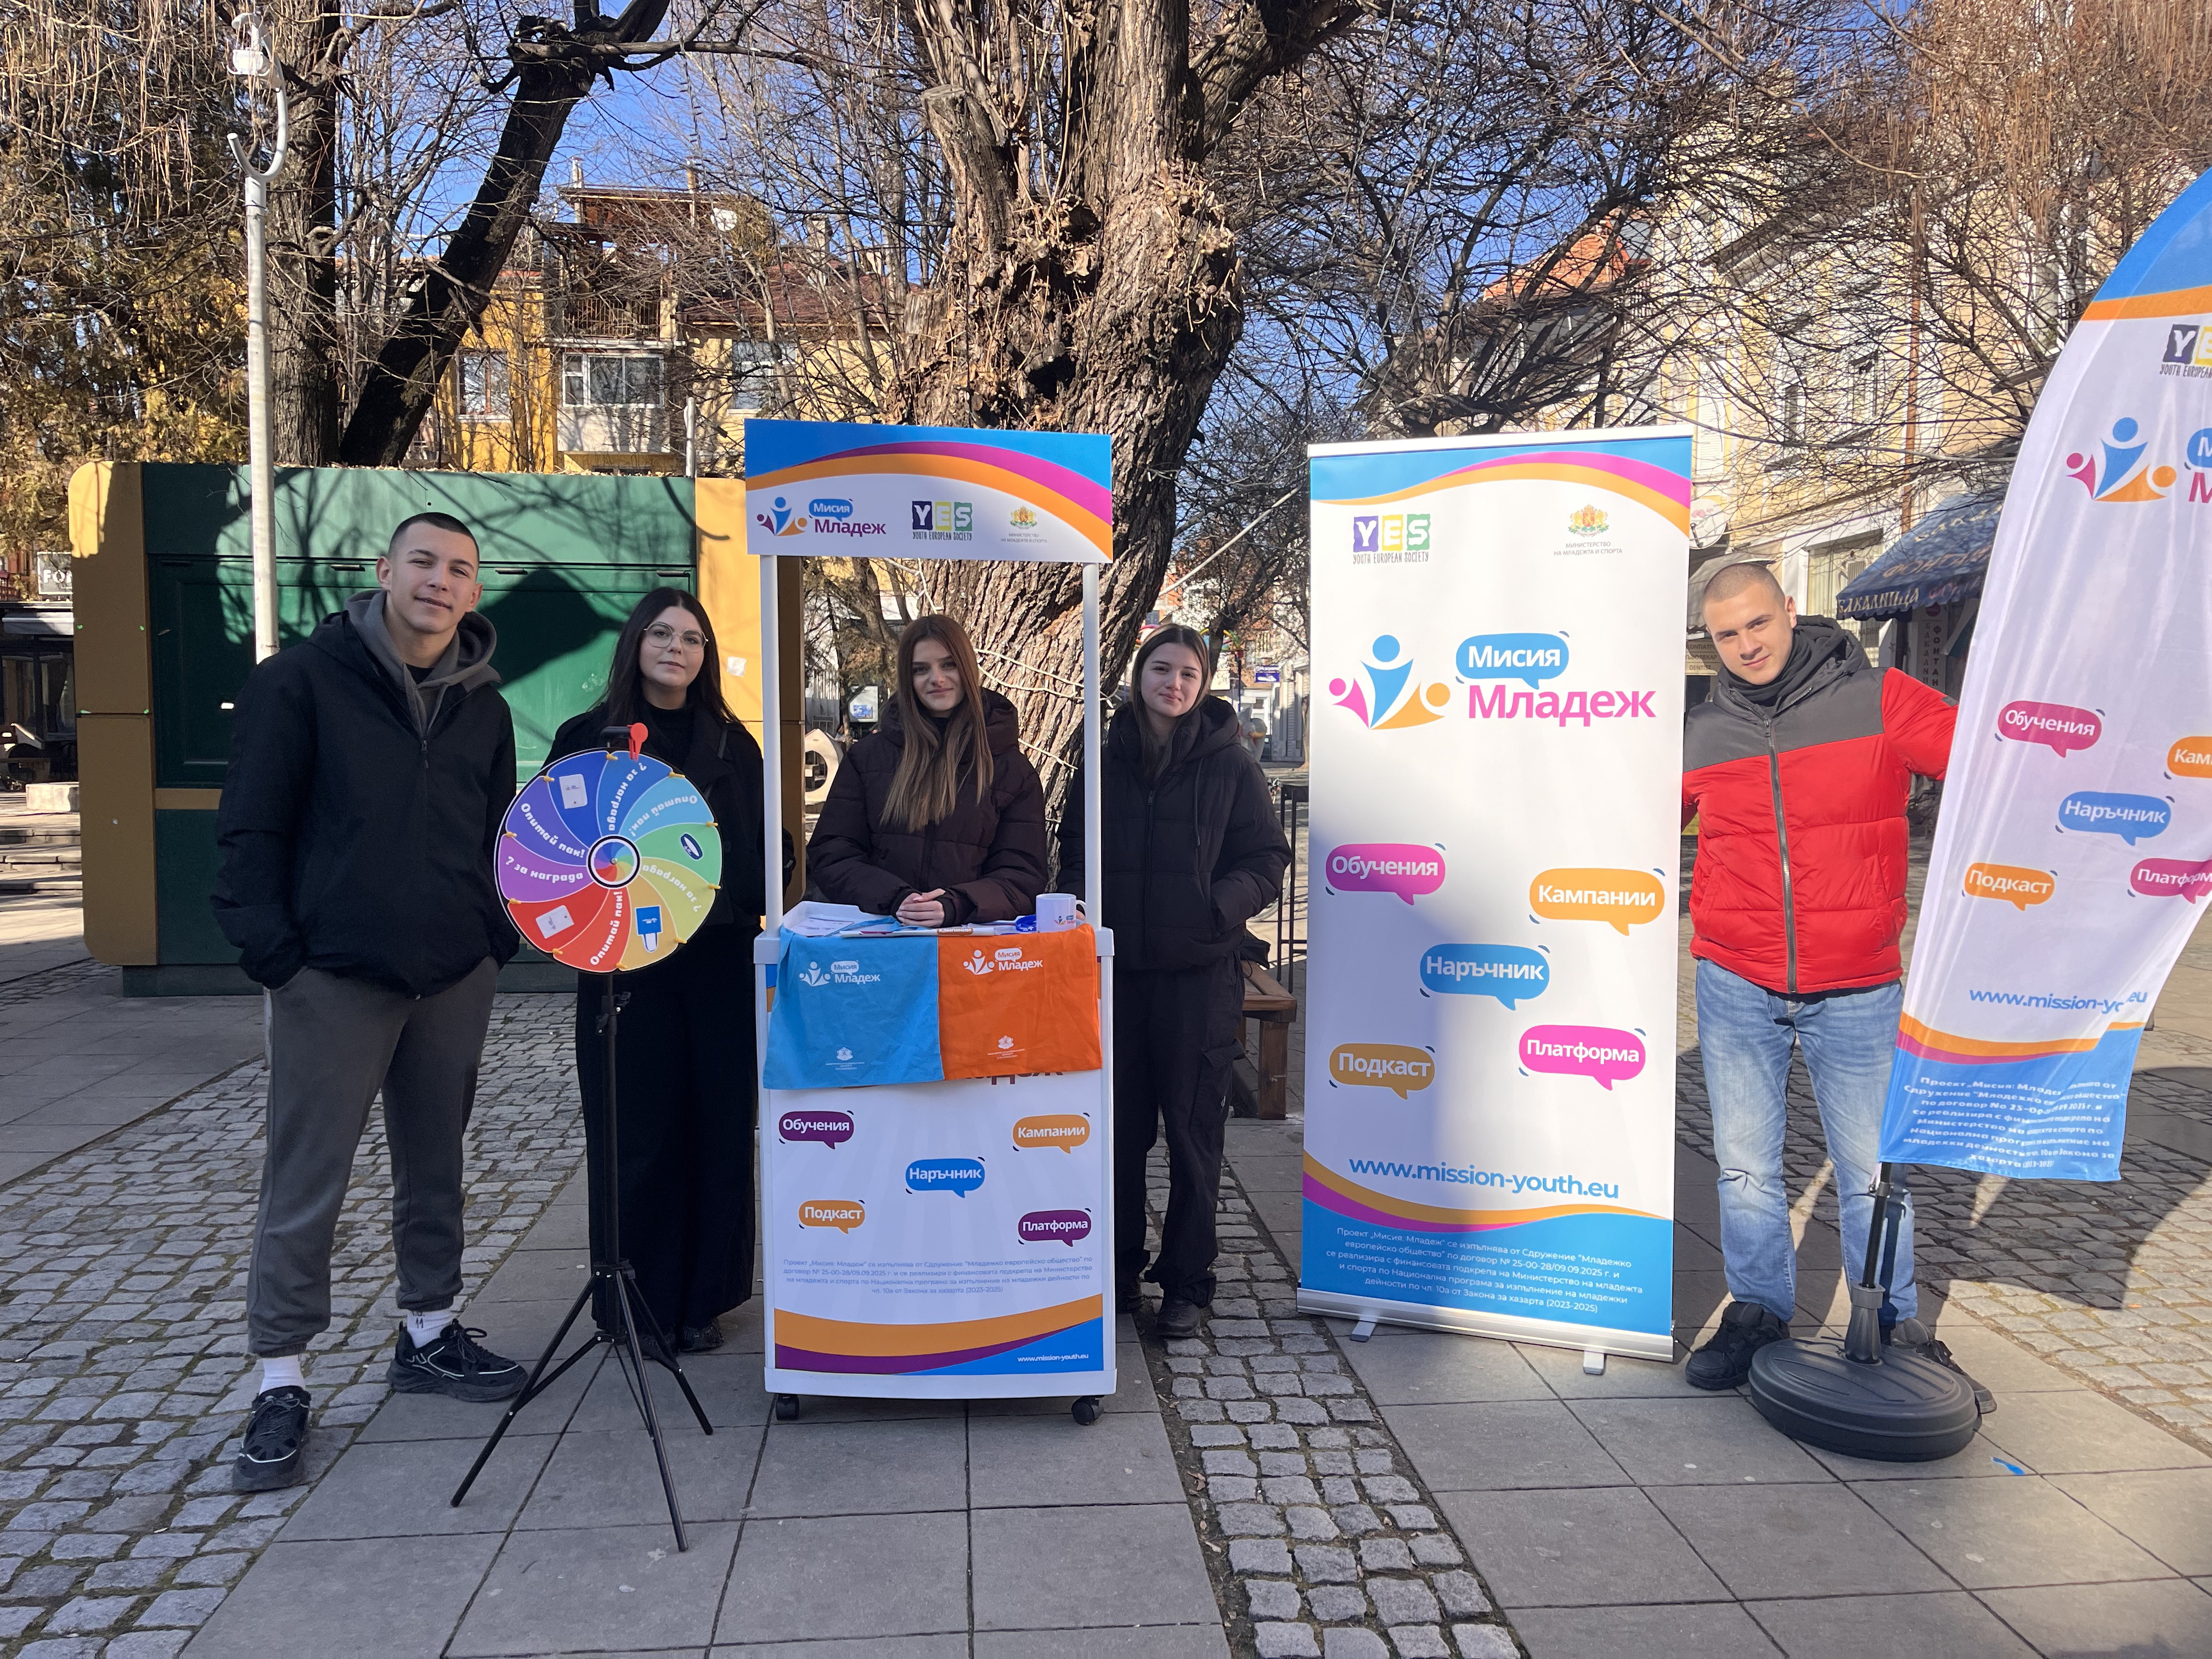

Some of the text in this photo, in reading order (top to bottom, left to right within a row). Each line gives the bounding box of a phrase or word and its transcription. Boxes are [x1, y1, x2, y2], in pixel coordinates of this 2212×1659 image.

[2159, 364, 2181, 376] YOUTH
[814, 503, 850, 513] Мисия
[913, 504, 971, 528] YES
[815, 519, 887, 537] Младеж
[912, 531, 972, 541] YOUTH EUROPEAN SOCIETY
[1355, 519, 1429, 547] YES
[1353, 551, 1429, 565] YOUTH EUROPEAN SOCIETY
[1468, 646, 1561, 668] Мисия
[1469, 685, 1657, 727] Младеж
[2005, 709, 2096, 736] Обучения
[607, 782, 628, 831] награда
[651, 795, 698, 817] Опитай
[2065, 800, 2167, 824] Наръчник
[521, 803, 585, 858] Опитай пак!
[506, 856, 584, 883] ? за награда
[642, 864, 687, 891] награда
[1331, 856, 1438, 879] Обучения
[1970, 870, 2051, 895] Подкаст
[1538, 885, 1656, 907] Кампании
[590, 920, 620, 966] Опитай
[998, 960, 1043, 972] Младеж
[1426, 956, 1544, 981] Наръчник
[834, 974, 881, 985] Младеж
[1527, 1039, 1639, 1063] Платформа
[1339, 1053, 1431, 1078] Подкаст
[1904, 1085, 1971, 1097] Сдружение
[1920, 1077, 1966, 1087] Проект
[1938, 1101, 1988, 1109] договор
[783, 1119, 850, 1132] Обучения
[1018, 1125, 1086, 1138] Кампании
[1910, 1127, 1989, 1139] Национална
[1917, 1118, 2006, 1131] Министерство
[909, 1167, 982, 1183] Наръчник
[1348, 1158, 1620, 1200] www.mission-youth.eu
[804, 1207, 862, 1222] Подкаст
[1023, 1219, 1088, 1233] Платформа
[1337, 1227, 1369, 1237] Проект
[1460, 1242, 1508, 1254] изпълнява
[1522, 1248, 1576, 1261] Сдружение
[1345, 1241, 1397, 1252] европейско
[1460, 1254, 1498, 1265] договор
[1043, 1265, 1093, 1273] Министерство
[1338, 1252, 1385, 1263] реализира
[1393, 1257, 1451, 1271] финансовата
[1453, 1263, 1497, 1276] подкрепа
[1513, 1271, 1580, 1286] Министерство
[1596, 1282, 1643, 1294] младежта
[915, 1279, 948, 1287] програма
[1347, 1264, 1376, 1273] спорта
[1392, 1268, 1446, 1282] Национална
[1448, 1276, 1492, 1288] програма
[1506, 1284, 1563, 1296] изпълнение
[1579, 1292, 1628, 1304] младежки
[1364, 1278, 1407, 1289] дейности
[1436, 1285, 1449, 1294] 10а
[1463, 1289, 1495, 1300] Закона
[1509, 1295, 1544, 1306] хазарта
[1547, 1299, 1598, 1314] (2023-2025)
[1017, 1353, 1089, 1362] www.mission-youth.eu
